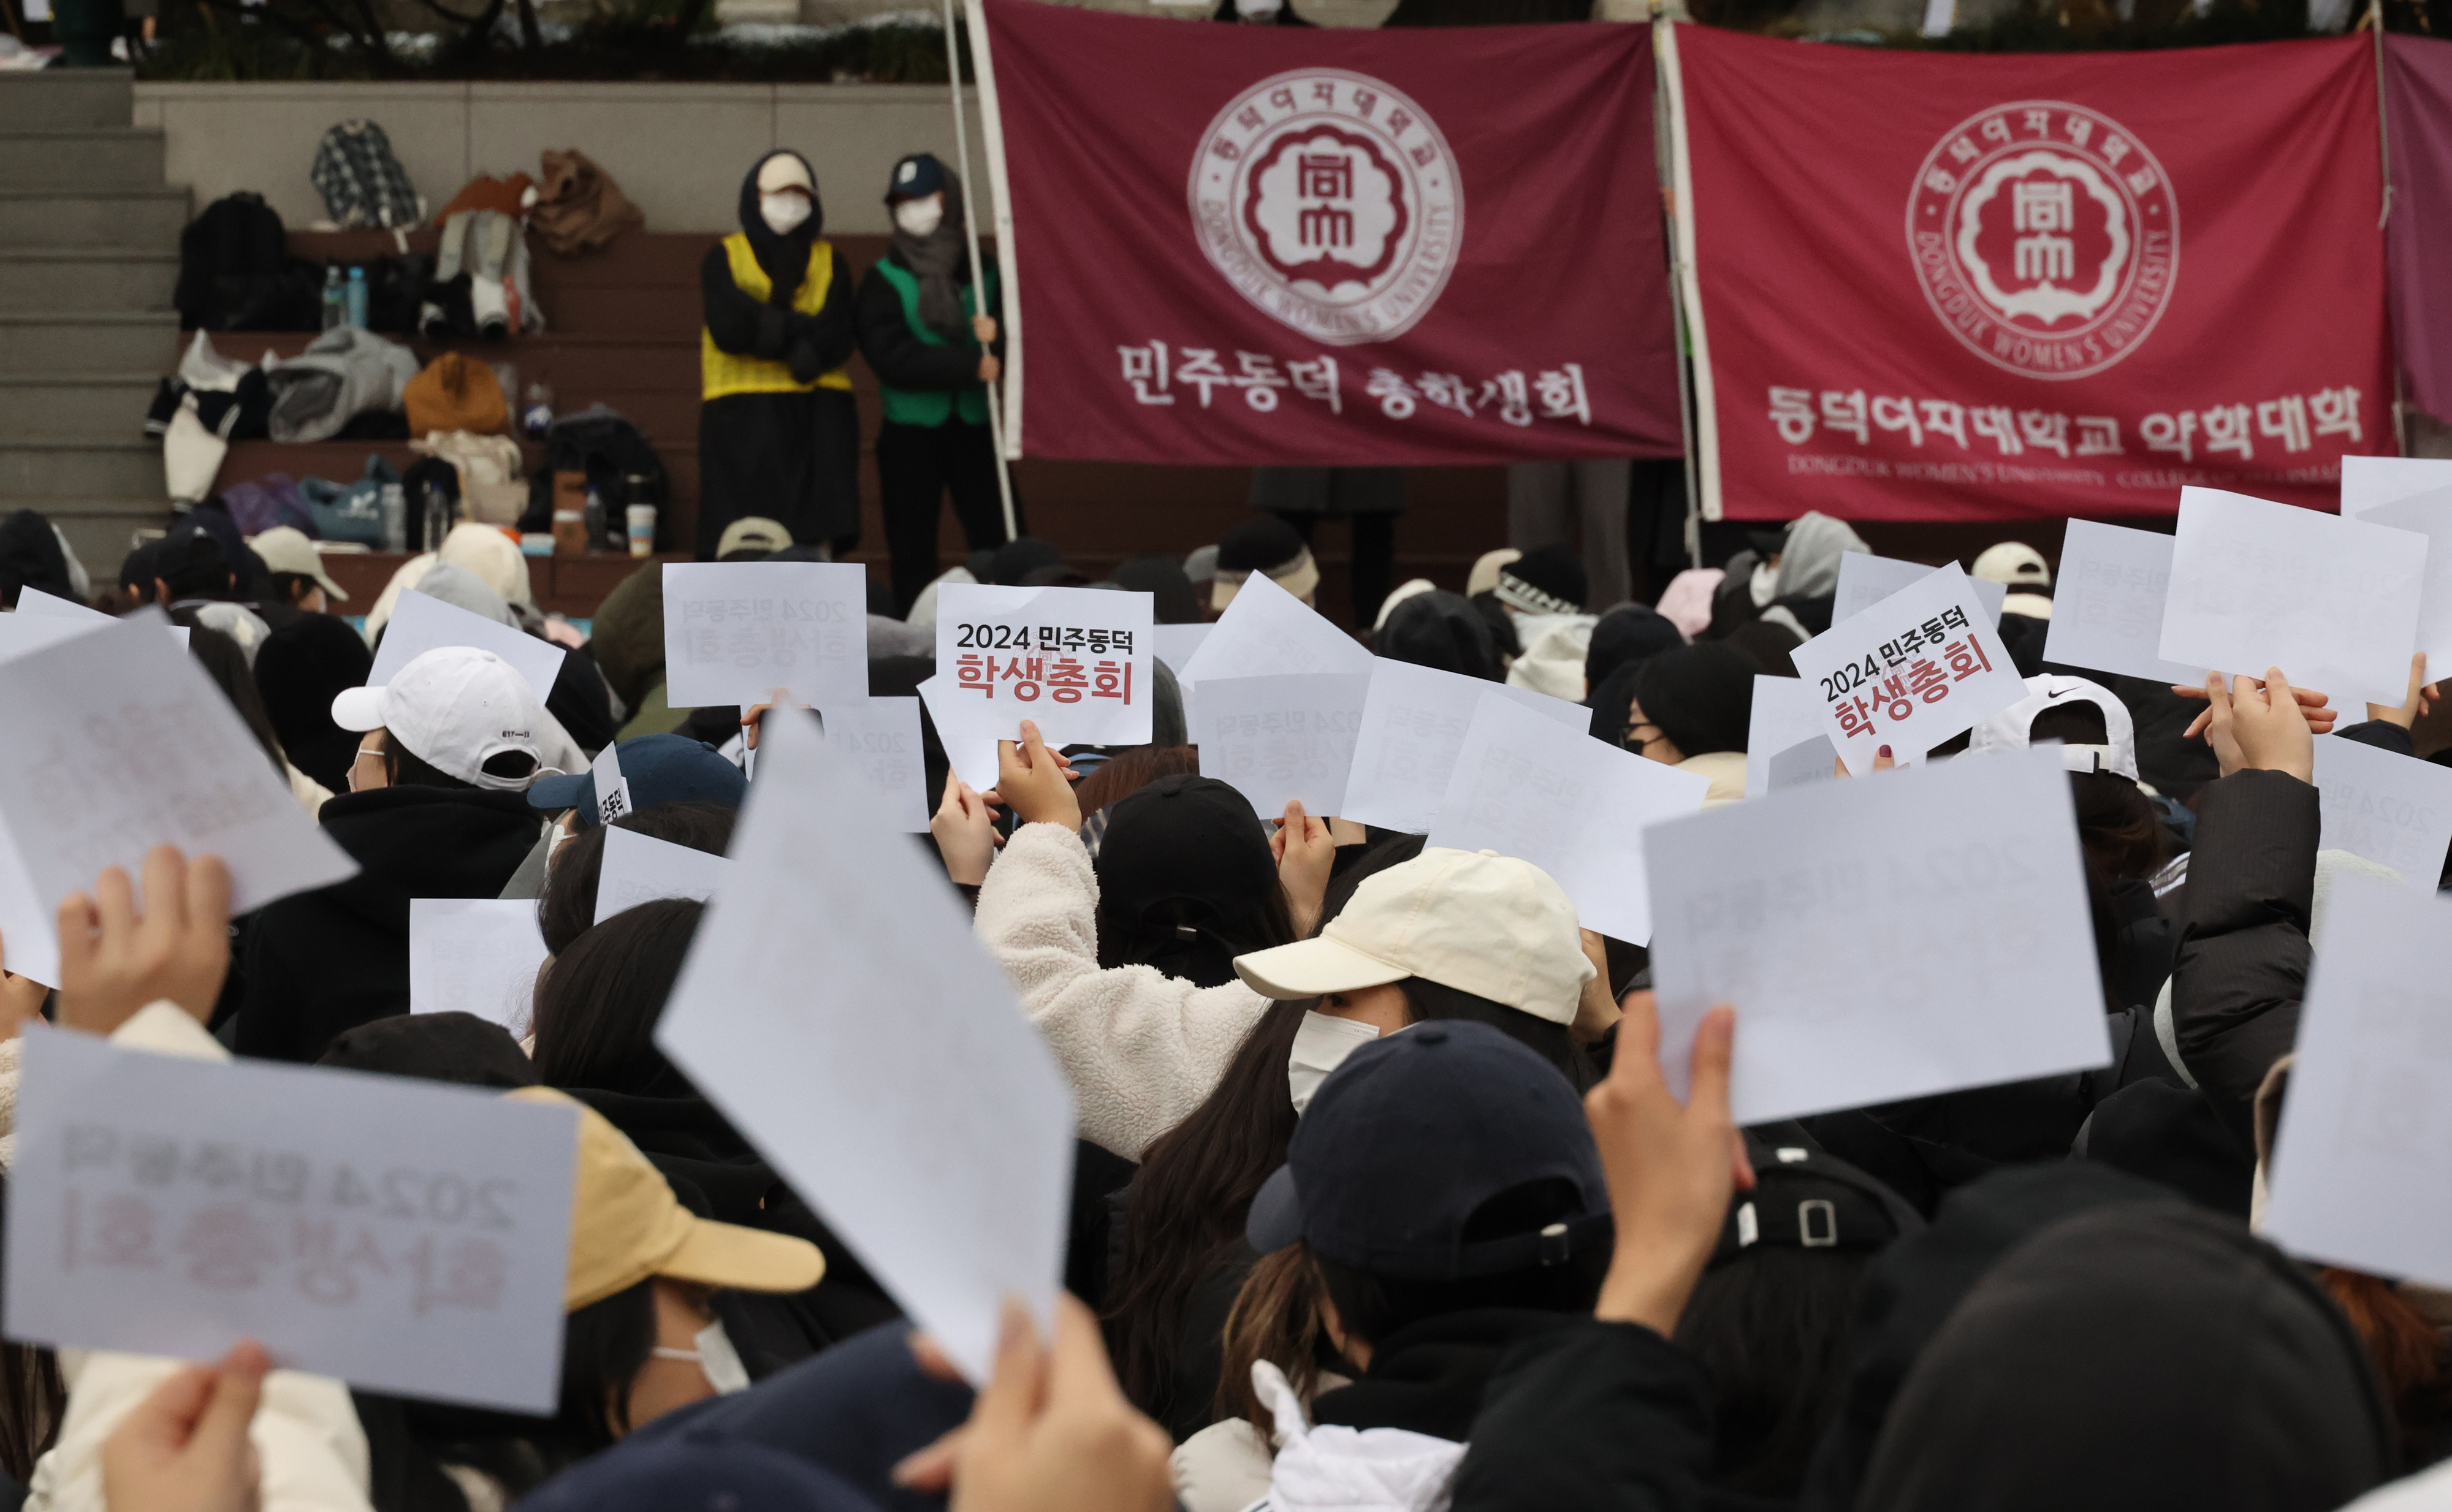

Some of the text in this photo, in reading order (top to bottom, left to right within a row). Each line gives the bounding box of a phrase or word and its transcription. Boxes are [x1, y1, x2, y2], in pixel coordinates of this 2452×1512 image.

[1926, 109, 2157, 195] 동덕여자대학교
[1917, 230, 1990, 340] DONGDUK
[1117, 339, 1593, 427] 민주동덕 총학생회
[1768, 386, 2362, 463] 동덕여자대학교 약학대학
[956, 654, 1132, 705] 학생총회
[957, 623, 1133, 655] 2024 민주동덕
[1820, 605, 1970, 702] 2024 민주동덕
[1835, 633, 1993, 739] 학생총회
